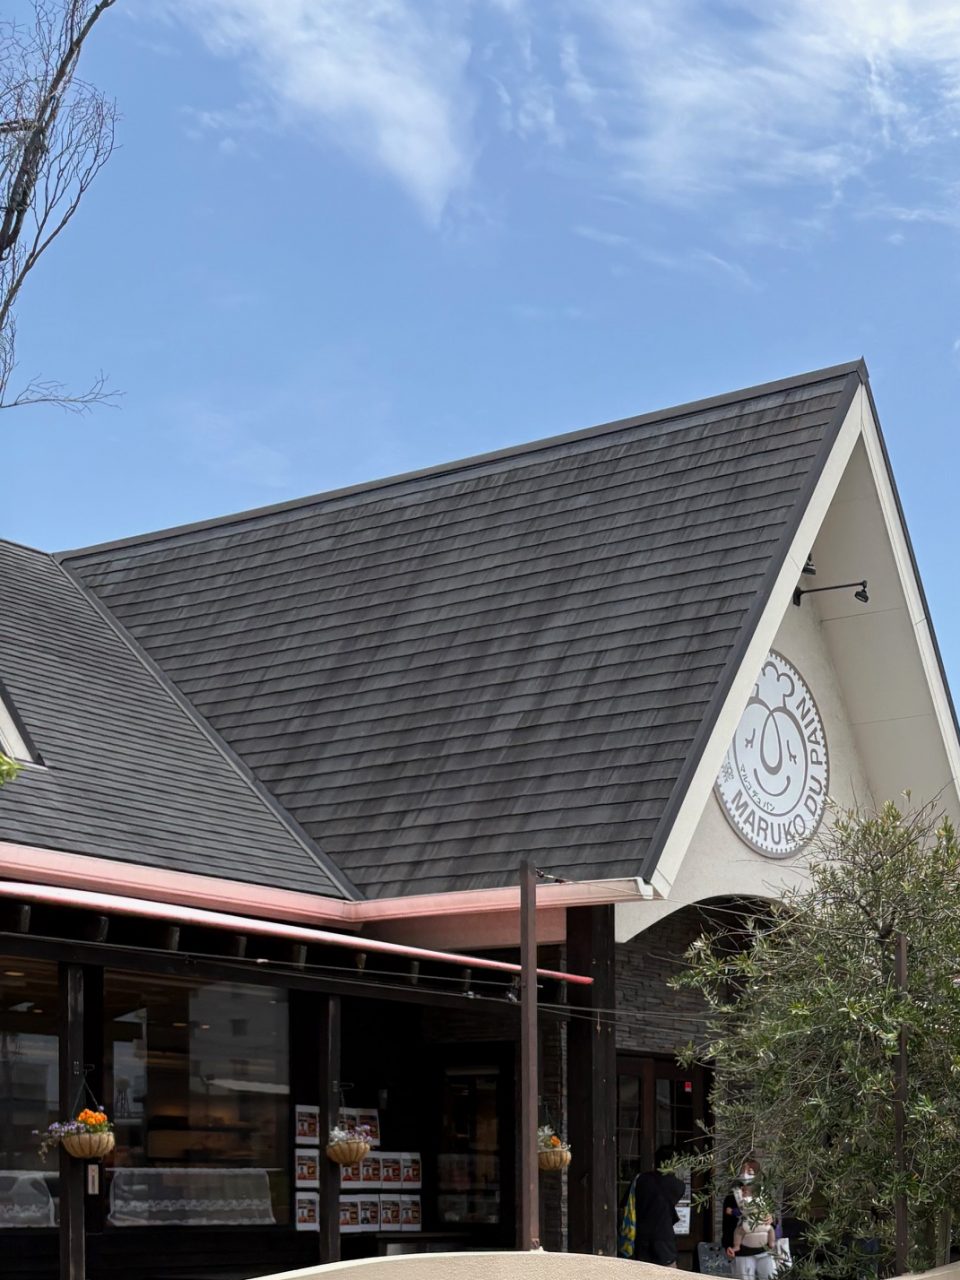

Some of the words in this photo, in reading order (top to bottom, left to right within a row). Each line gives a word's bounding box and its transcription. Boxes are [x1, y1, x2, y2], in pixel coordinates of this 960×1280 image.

[796, 696, 823, 766] PAIN
[731, 789, 806, 845] MARUKO
[804, 775, 823, 817] DU
